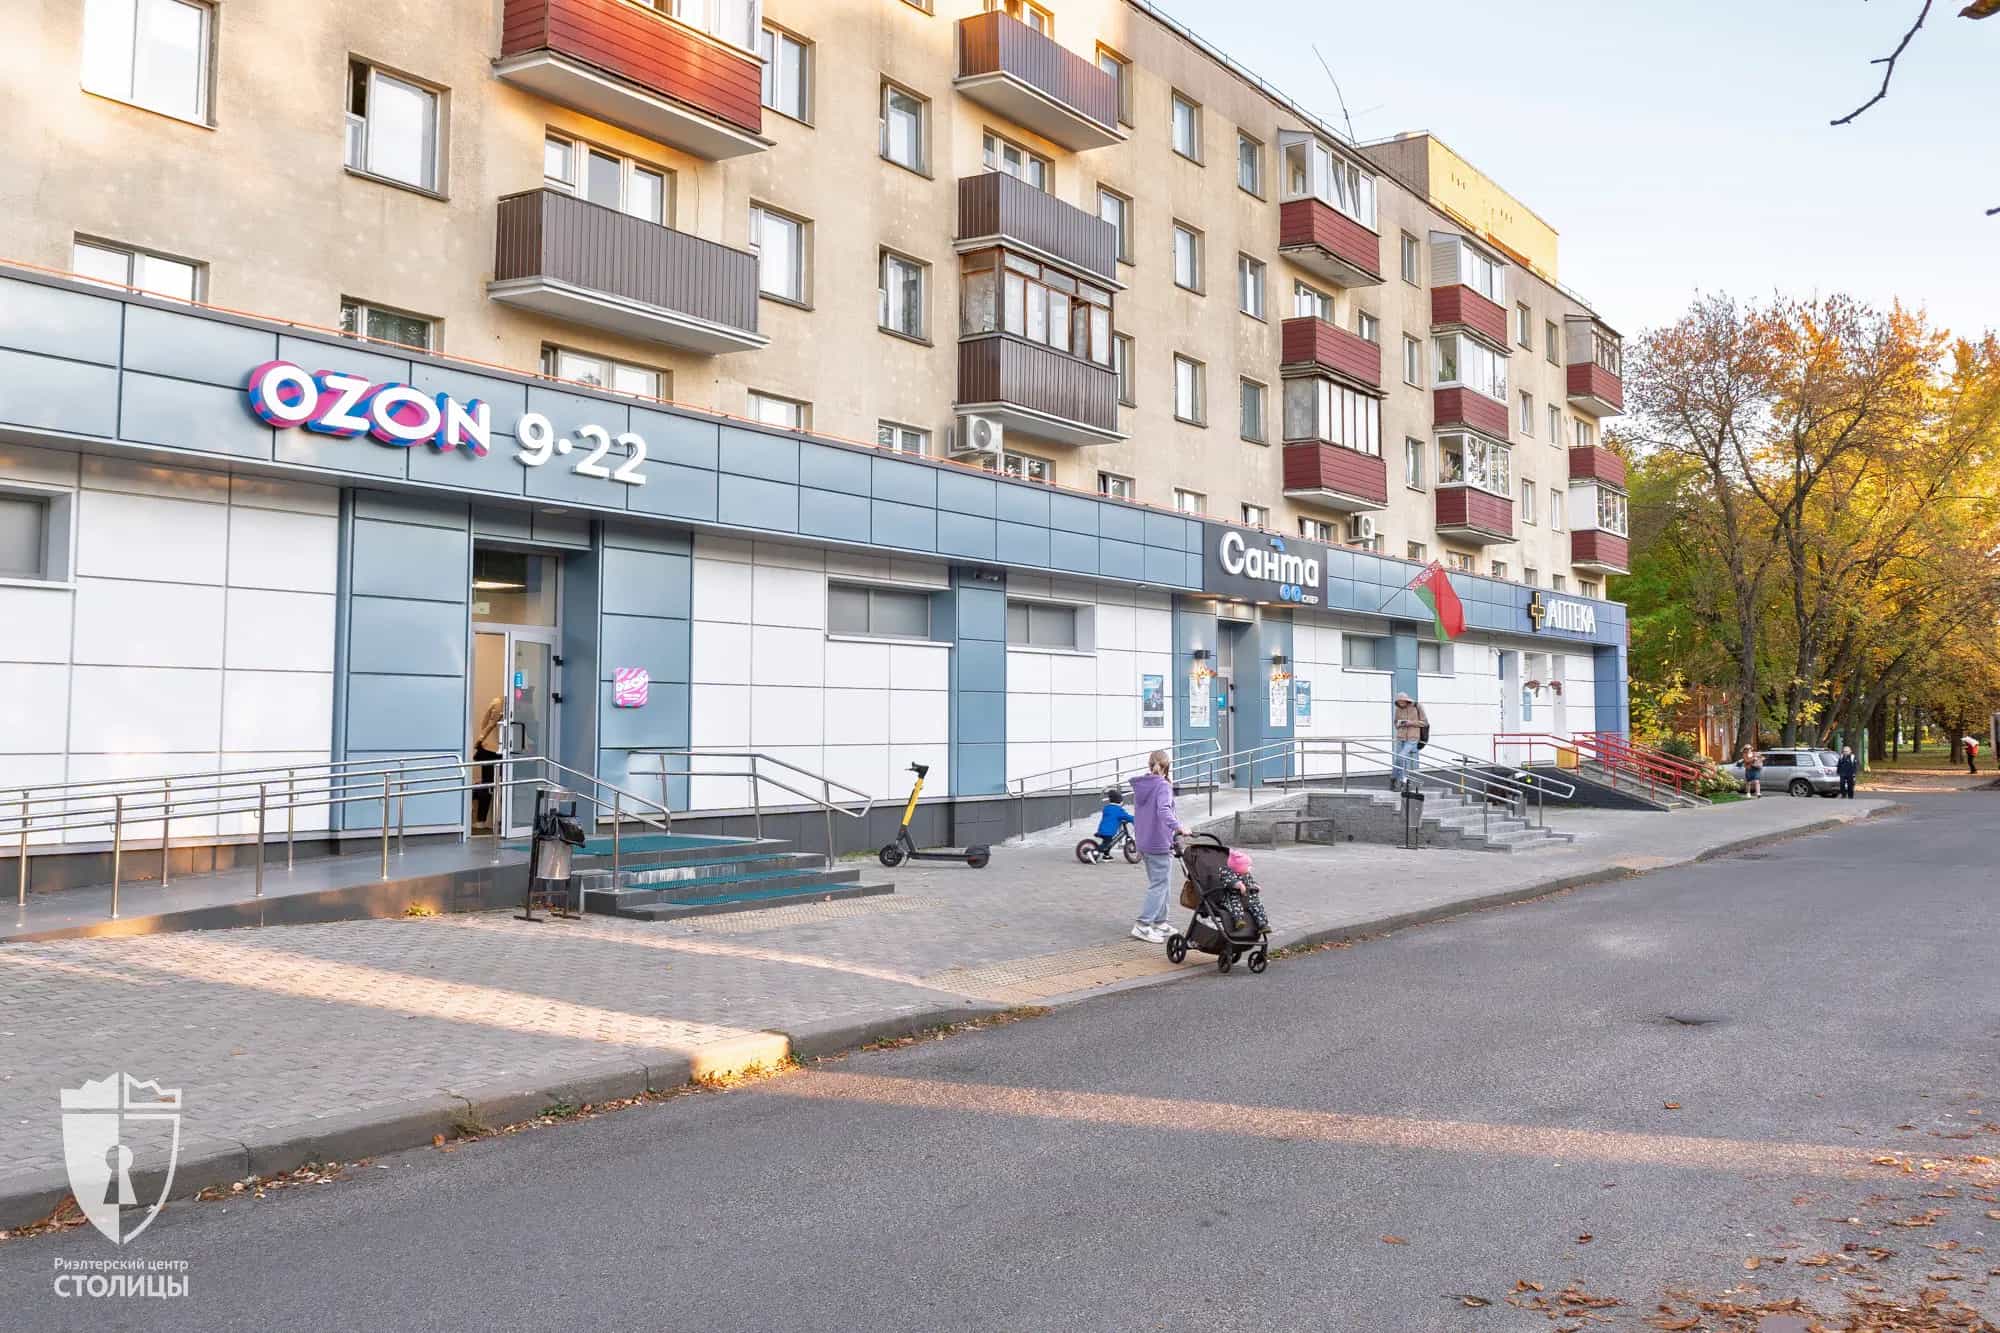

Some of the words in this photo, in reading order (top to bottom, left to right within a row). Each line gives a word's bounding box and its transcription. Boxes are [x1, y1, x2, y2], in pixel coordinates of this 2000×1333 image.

[252, 361, 491, 456] OZON
[1220, 531, 1319, 588] Санта
[1545, 598, 1597, 634] АПТЕКА
